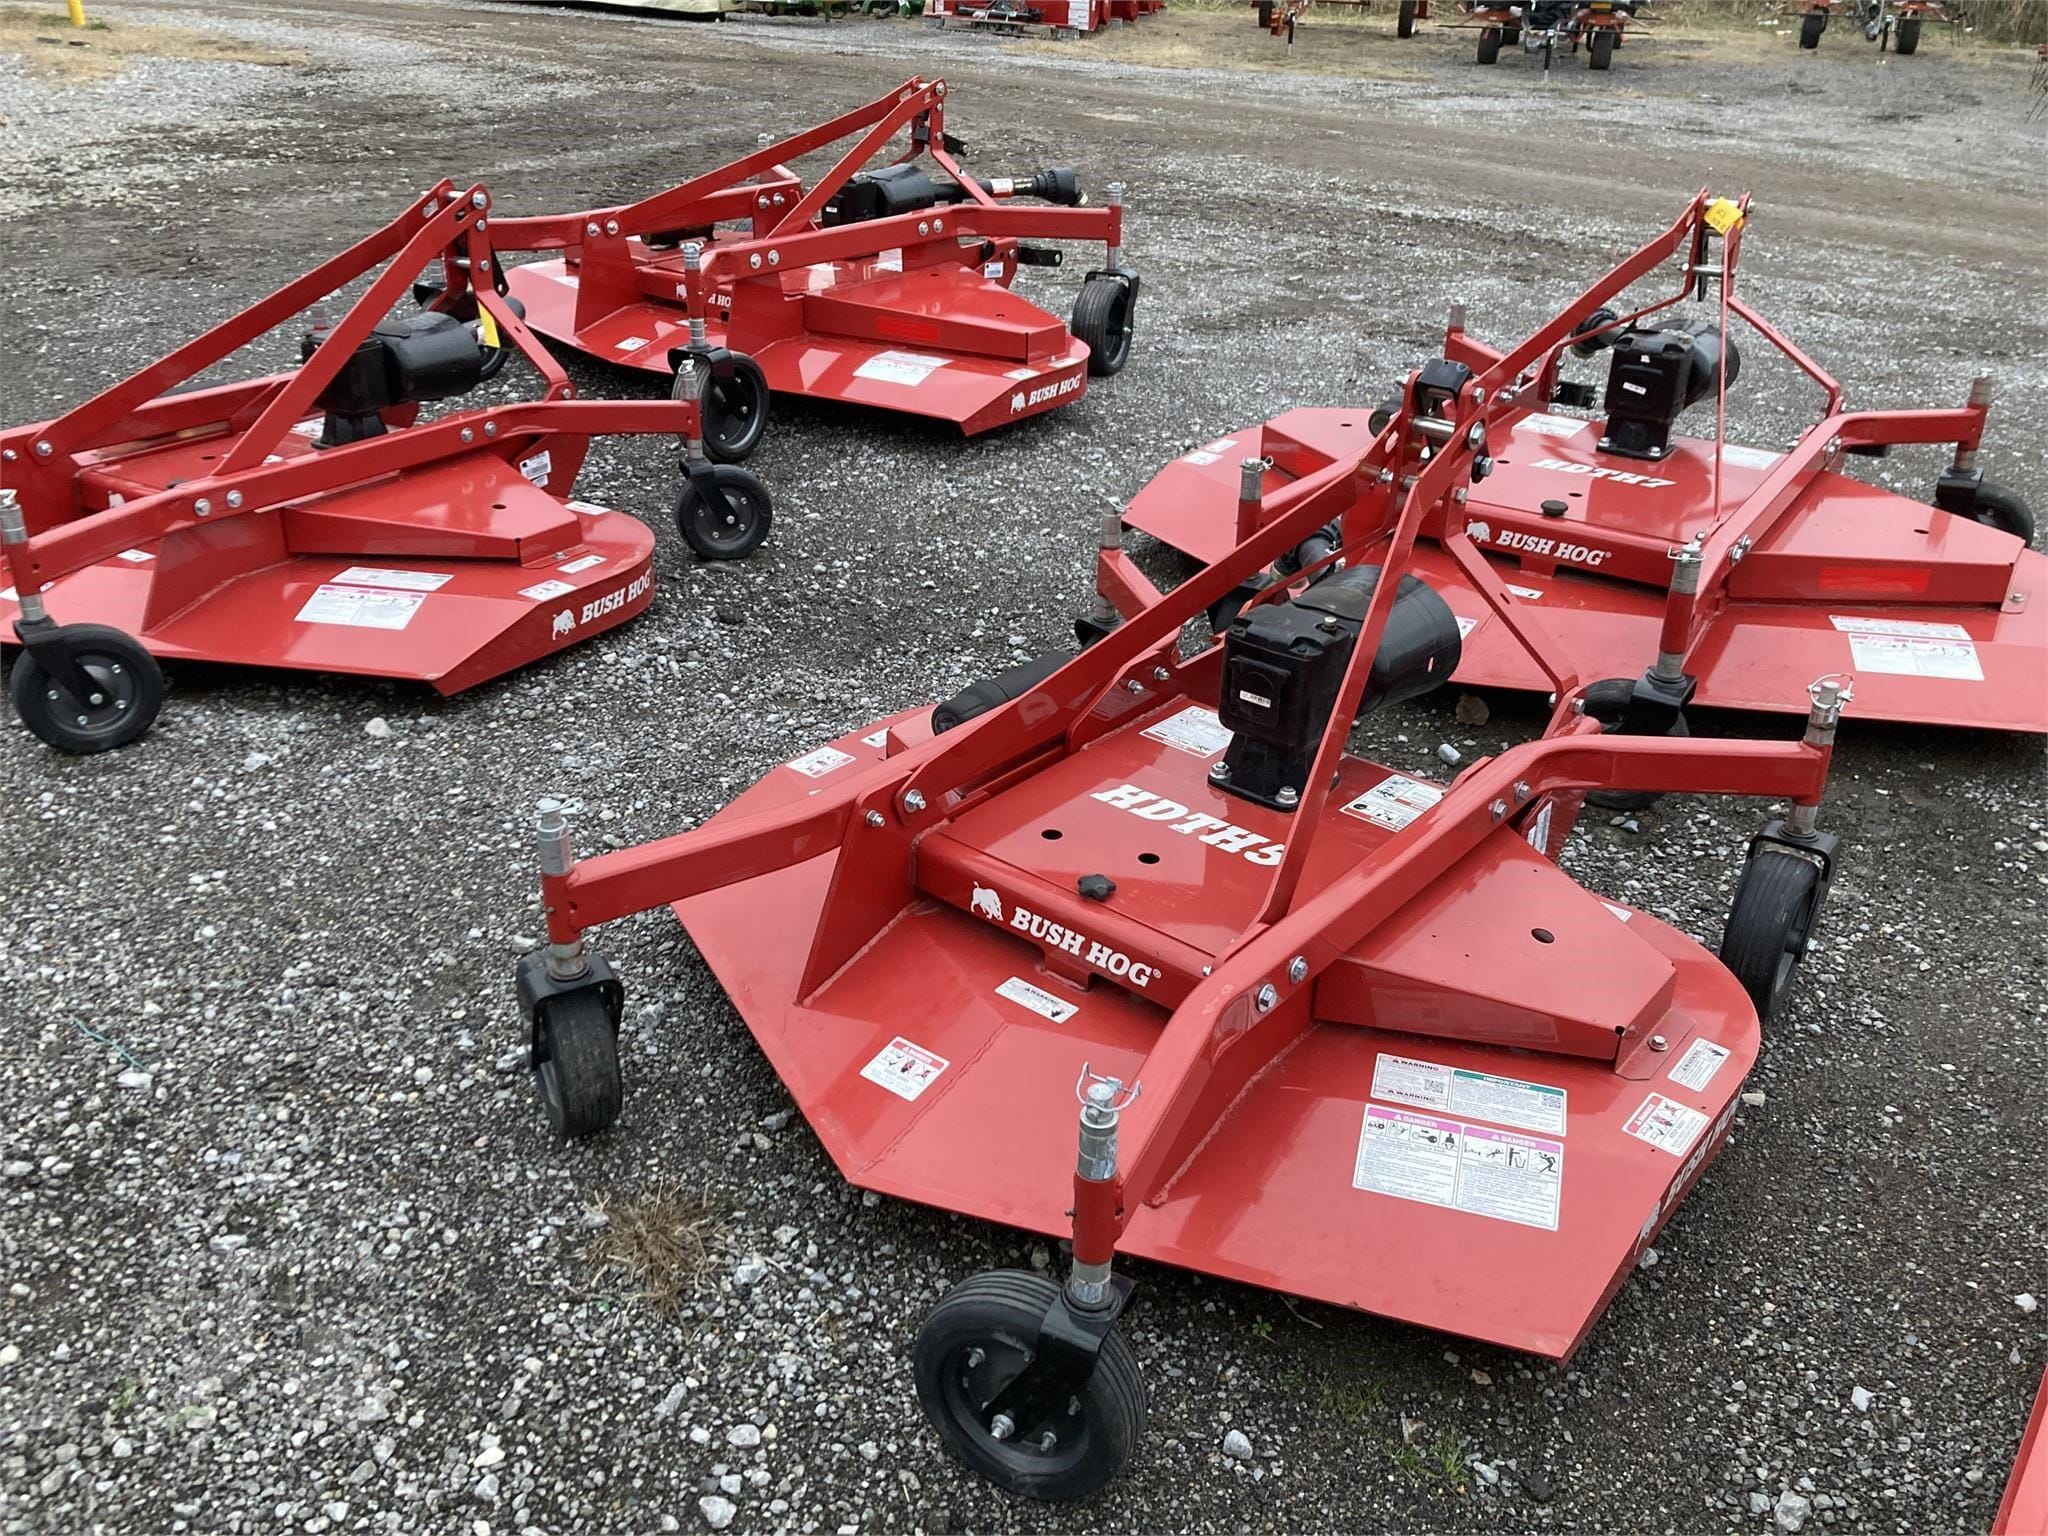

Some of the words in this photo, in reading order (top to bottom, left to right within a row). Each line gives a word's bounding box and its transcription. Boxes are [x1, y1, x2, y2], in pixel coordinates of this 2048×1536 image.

[717, 295, 732, 308] HO
[1028, 383, 1059, 406] BUSH
[1529, 458, 1677, 489] HDTH7
[1495, 529, 1555, 554] BUSH
[580, 588, 626, 625] BUSH
[1089, 783, 1286, 867] HDTH5
[1010, 905, 1086, 957] BUSH
[1400, 1060, 1439, 1072] WARNING
[1483, 1076, 1531, 1089] IMPORTANT
[1396, 1090, 1436, 1102] WARNING
[1403, 1116, 1438, 1128] DANGER
[1501, 1135, 1537, 1148] DANGER
